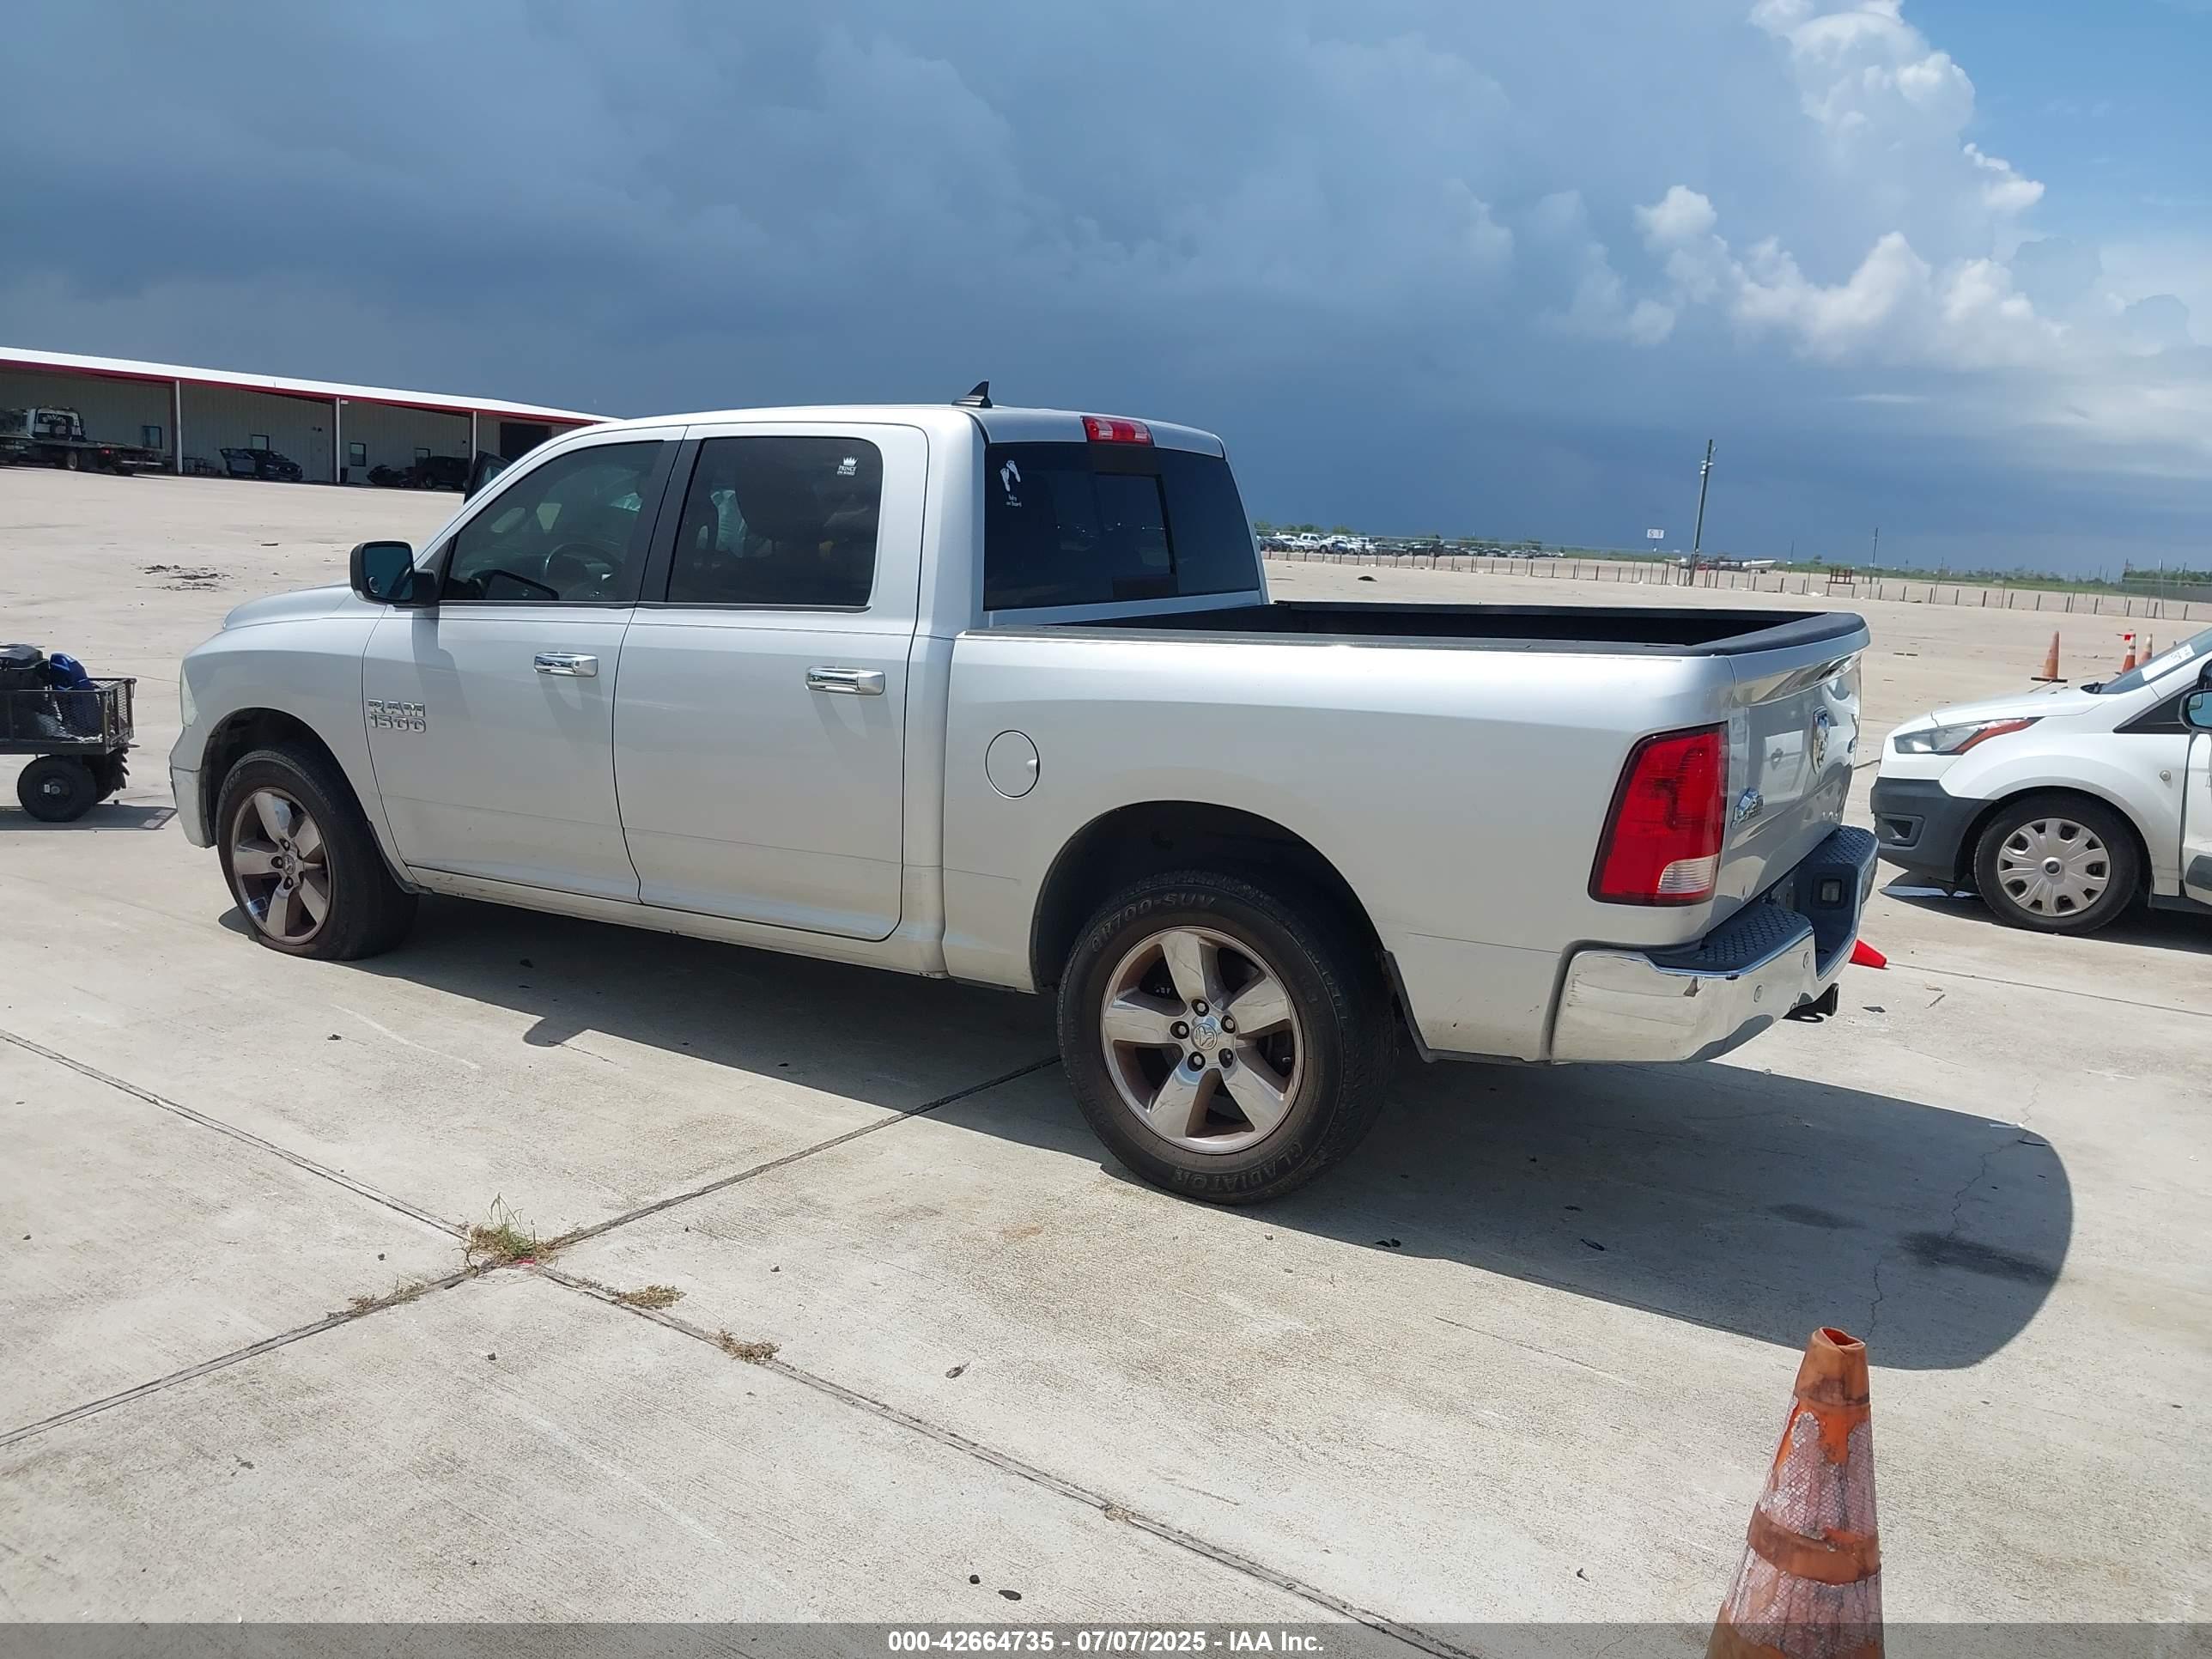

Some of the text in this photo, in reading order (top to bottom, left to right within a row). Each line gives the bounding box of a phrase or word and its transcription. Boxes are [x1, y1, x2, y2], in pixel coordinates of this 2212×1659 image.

[368, 699, 426, 718] RAM
[369, 713, 427, 734] 1500
[1173, 1139, 1304, 1192] GLADIATOR
